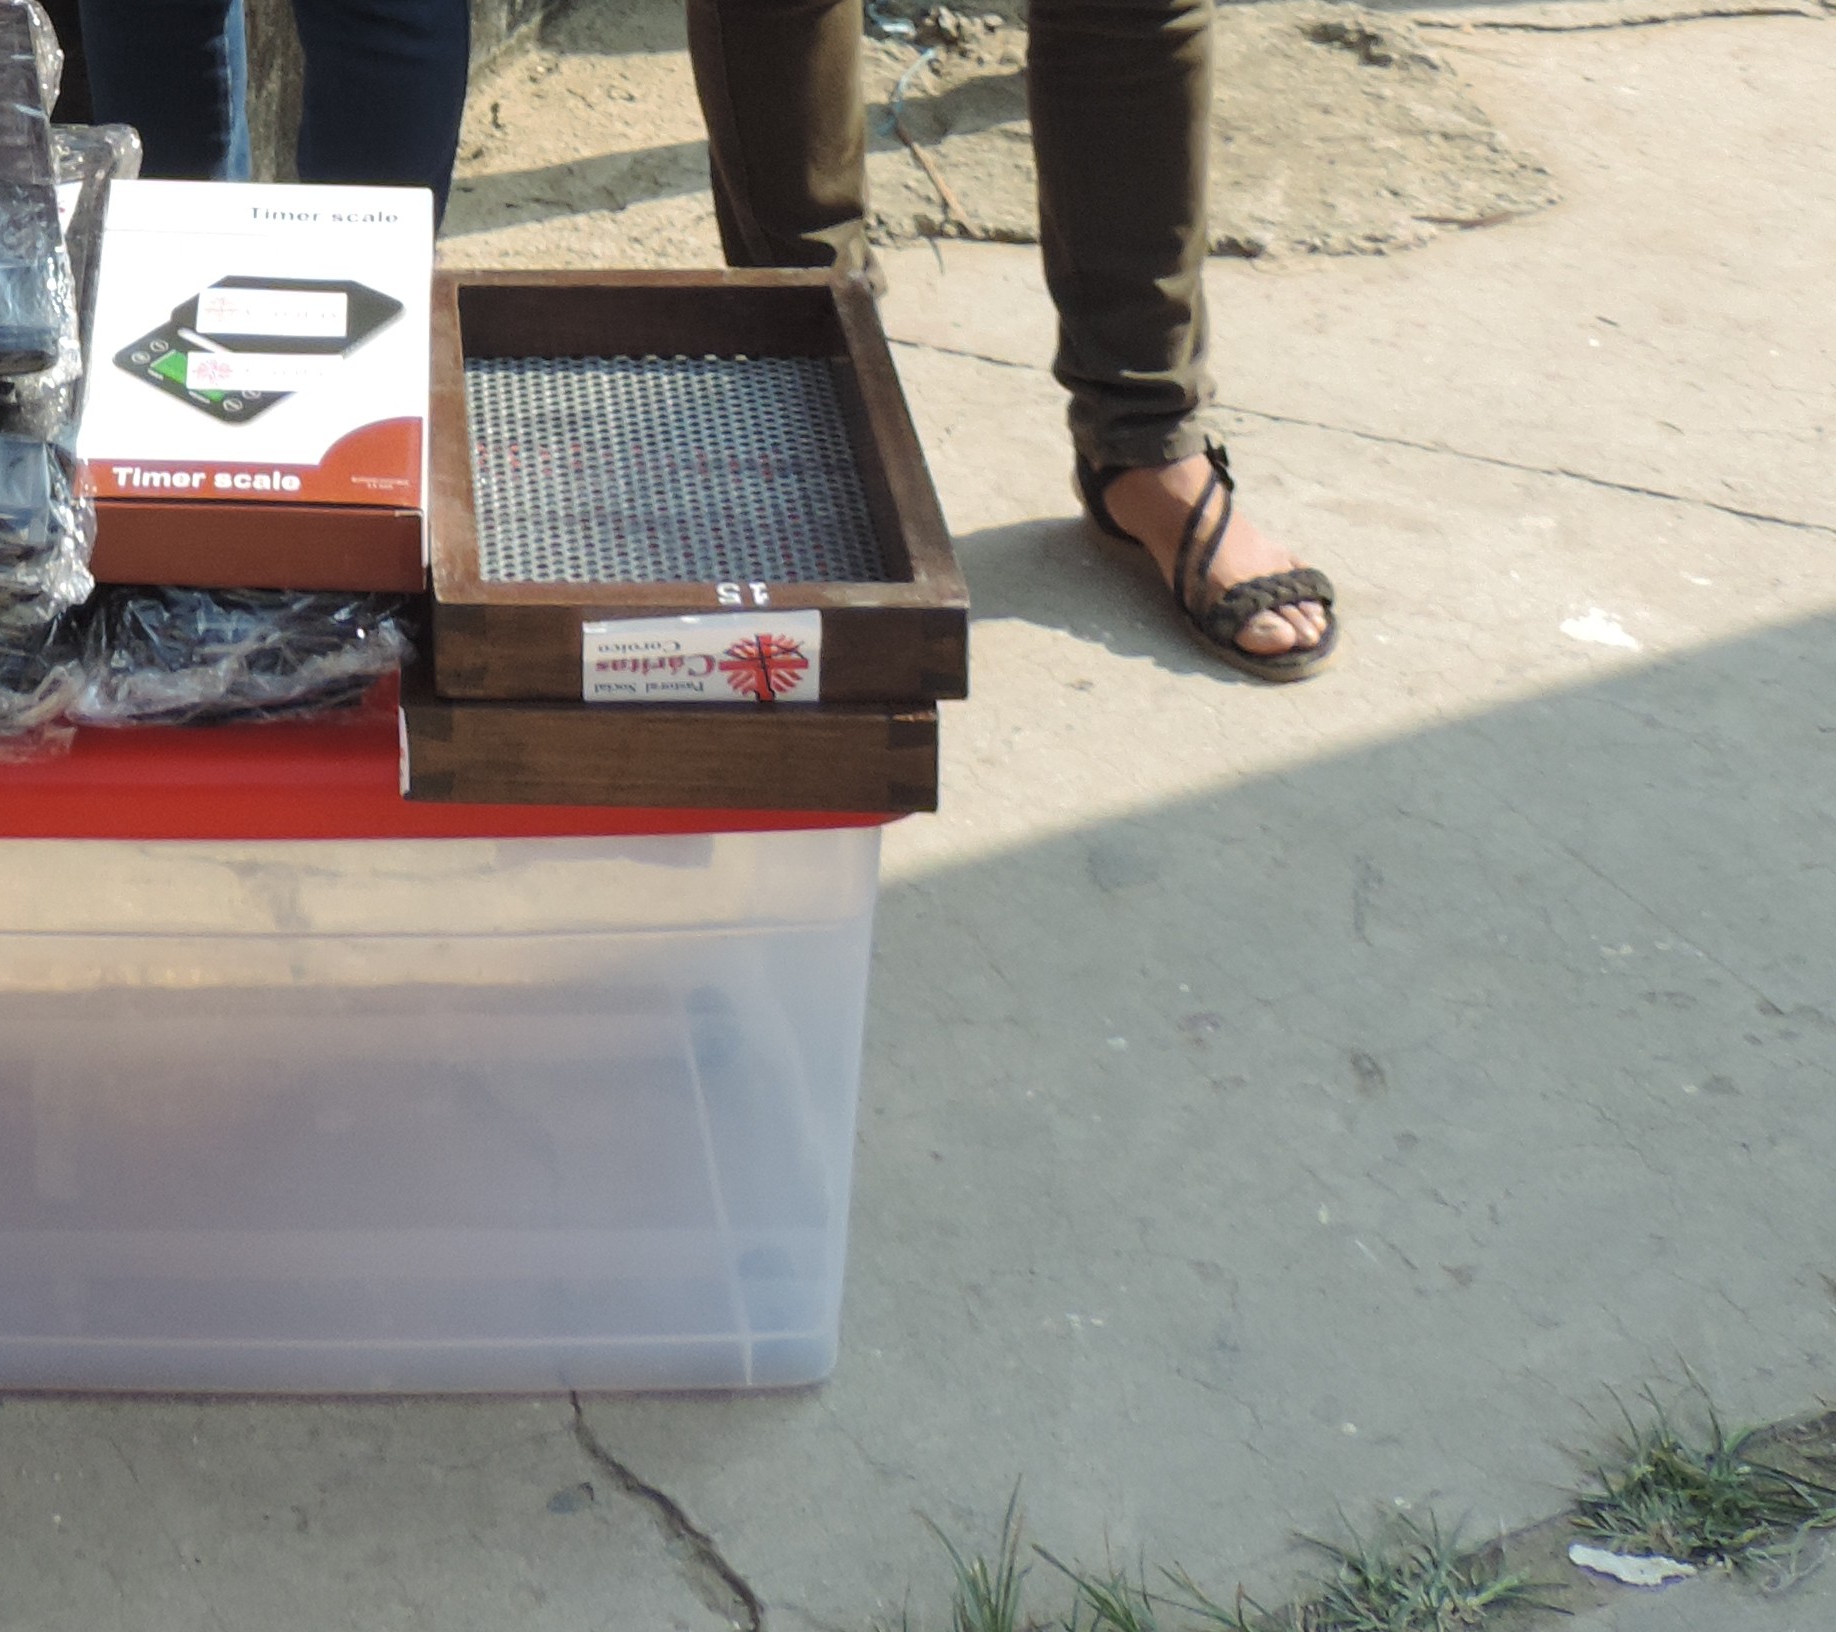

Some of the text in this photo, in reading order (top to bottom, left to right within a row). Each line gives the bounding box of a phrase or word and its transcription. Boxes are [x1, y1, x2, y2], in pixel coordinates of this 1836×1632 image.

[251, 207, 399, 224] Timer scale
[111, 466, 302, 492] Timer scale
[594, 653, 716, 677] Cáritas
[593, 680, 705, 694] Pastoral Social
